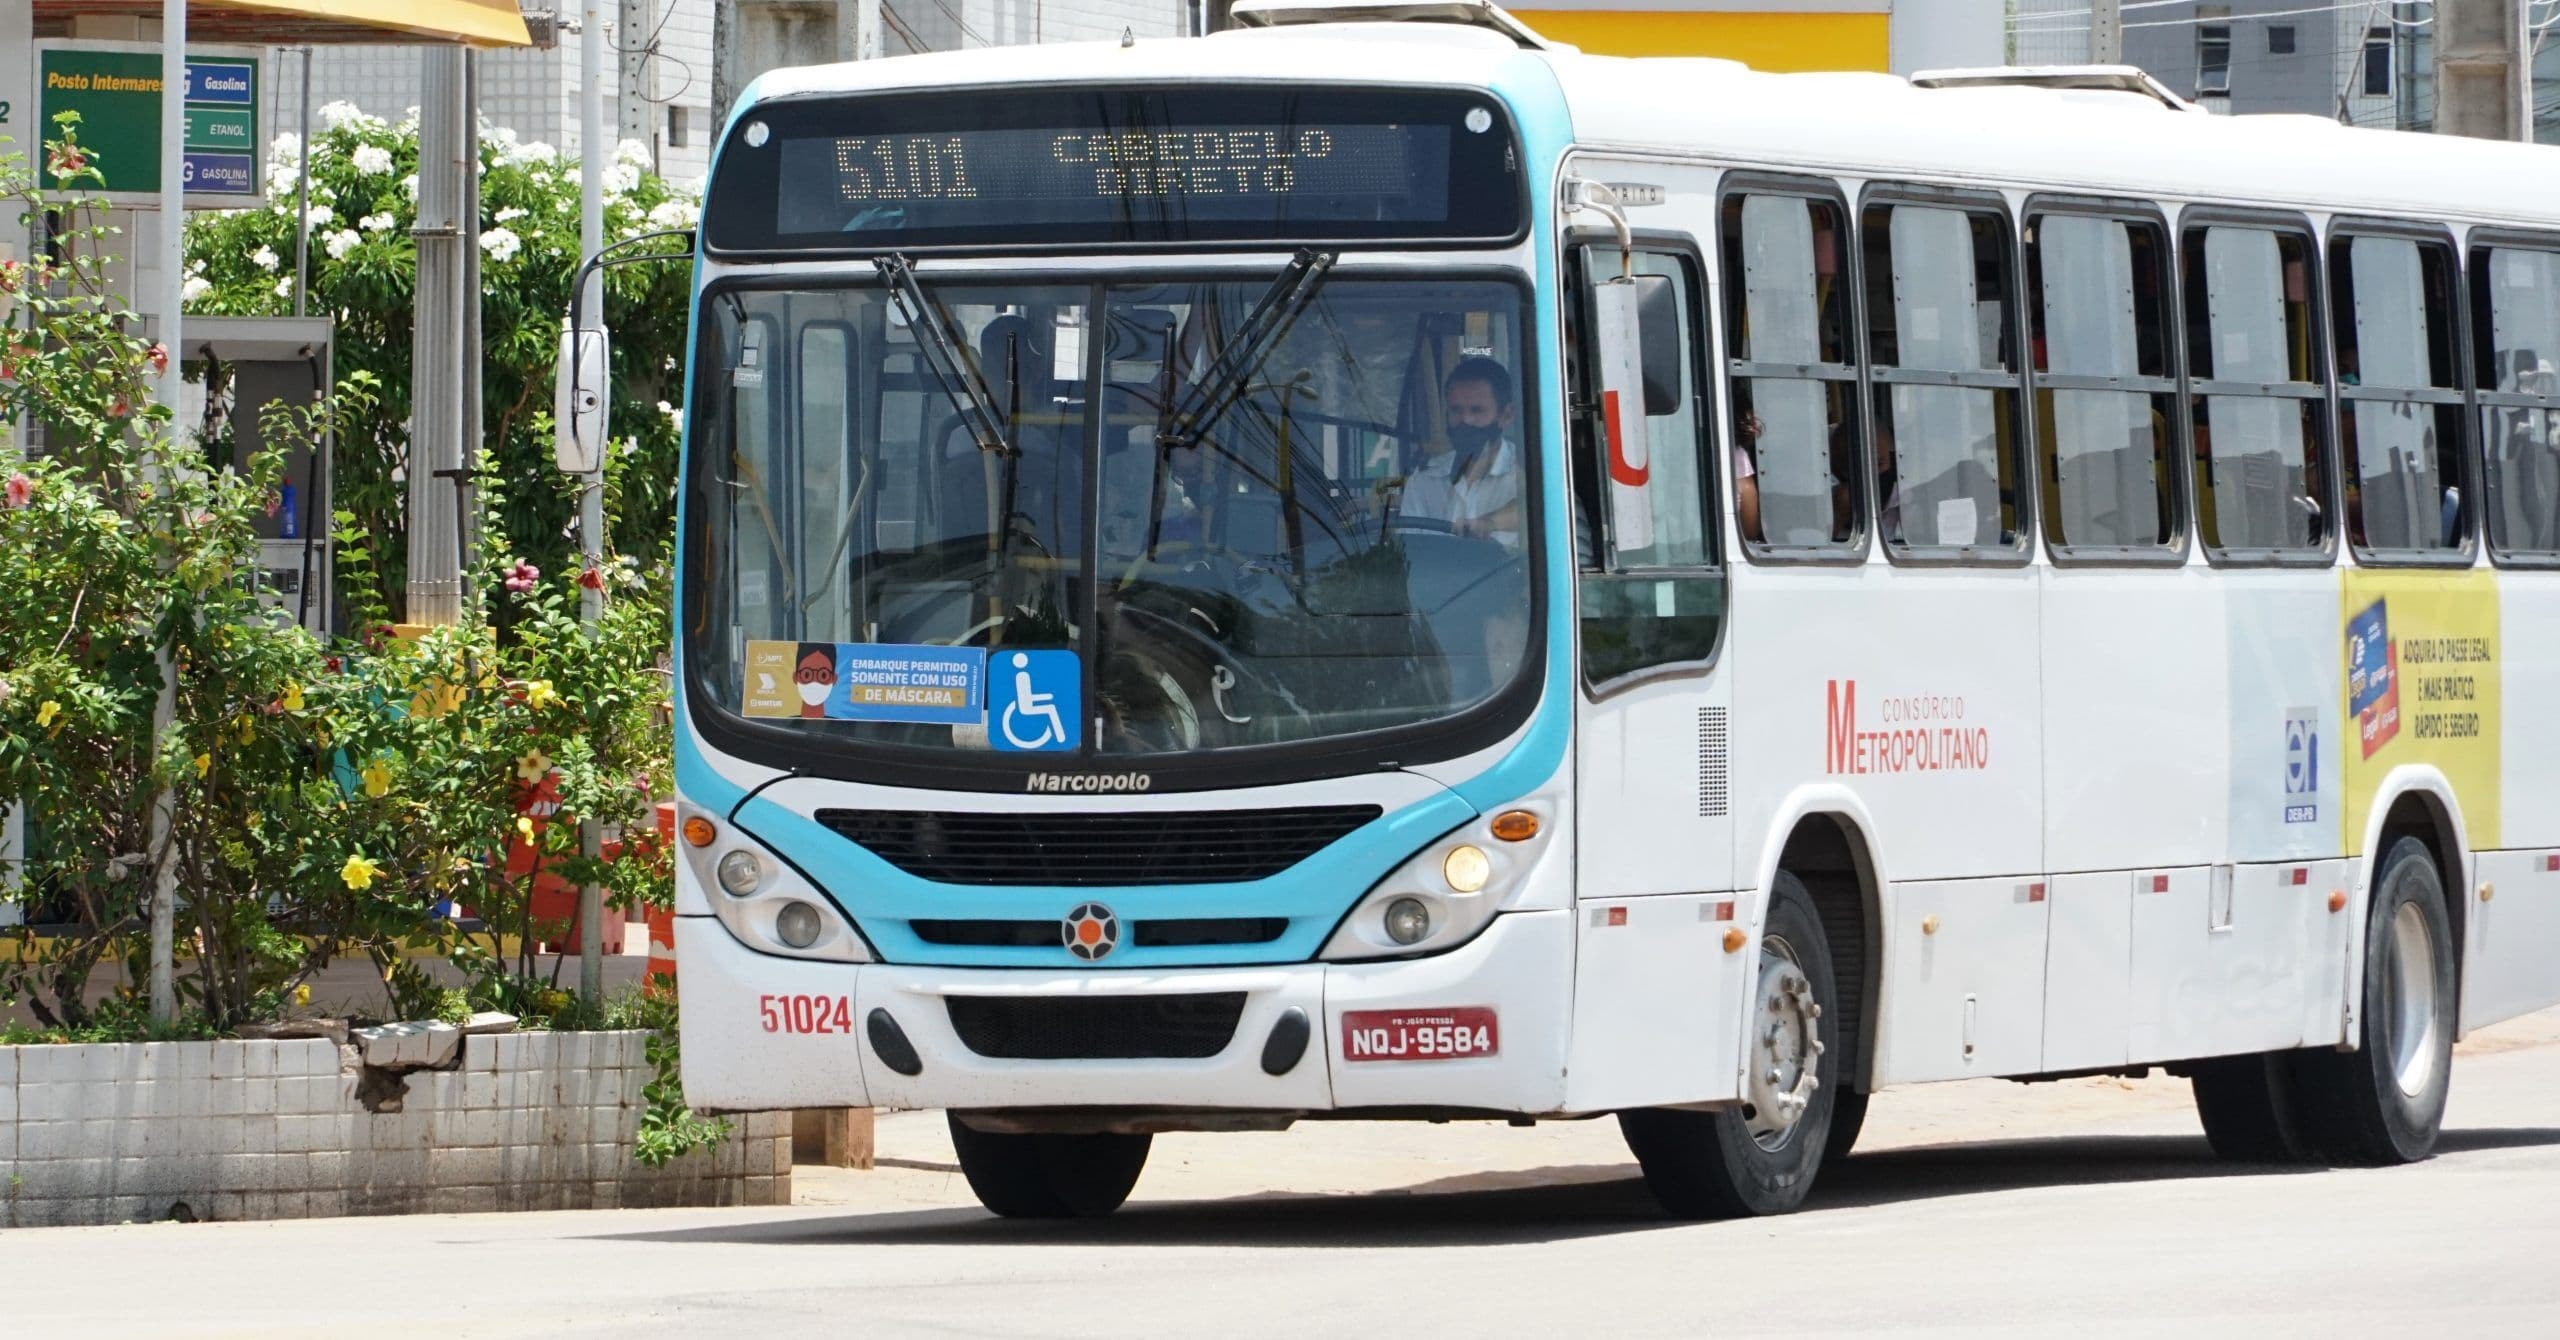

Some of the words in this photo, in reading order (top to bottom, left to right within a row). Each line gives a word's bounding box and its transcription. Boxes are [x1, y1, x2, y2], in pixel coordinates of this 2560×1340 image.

[48, 72, 89, 90] Posto
[205, 76, 247, 92] Gasolina
[210, 124, 245, 136] ETANOL
[202, 168, 247, 180] GASOLINA
[836, 138, 977, 199] 5101
[1053, 130, 1332, 162] CABEDELO
[1096, 164, 1296, 196] DIRETO
[2404, 639, 2436, 663] ADQUIRA
[2439, 639, 2444, 662] O
[2446, 638, 2467, 661] PASSE
[2470, 638, 2491, 661] LEGAL
[852, 659, 908, 671] EMBARQUE
[911, 661, 967, 673] PERMITIDO
[852, 672, 908, 684] SOMENTE
[911, 674, 939, 686] COM
[942, 675, 967, 687] USO
[2424, 678, 2442, 700] MAIS
[865, 689, 882, 701] DE
[886, 687, 952, 704] MÁSCARA
[1882, 688, 1964, 722] CONSÓRCIO
[1826, 679, 1988, 775] METROPOLITANO
[2415, 706, 2442, 738] RÁPIDO
[2444, 713, 2448, 738] E
[2450, 713, 2479, 737] SEGURO
[1026, 772, 1151, 792] Marcopolo
[760, 994, 851, 1034] 51024
[1426, 1017, 1455, 1025] PESSOA
